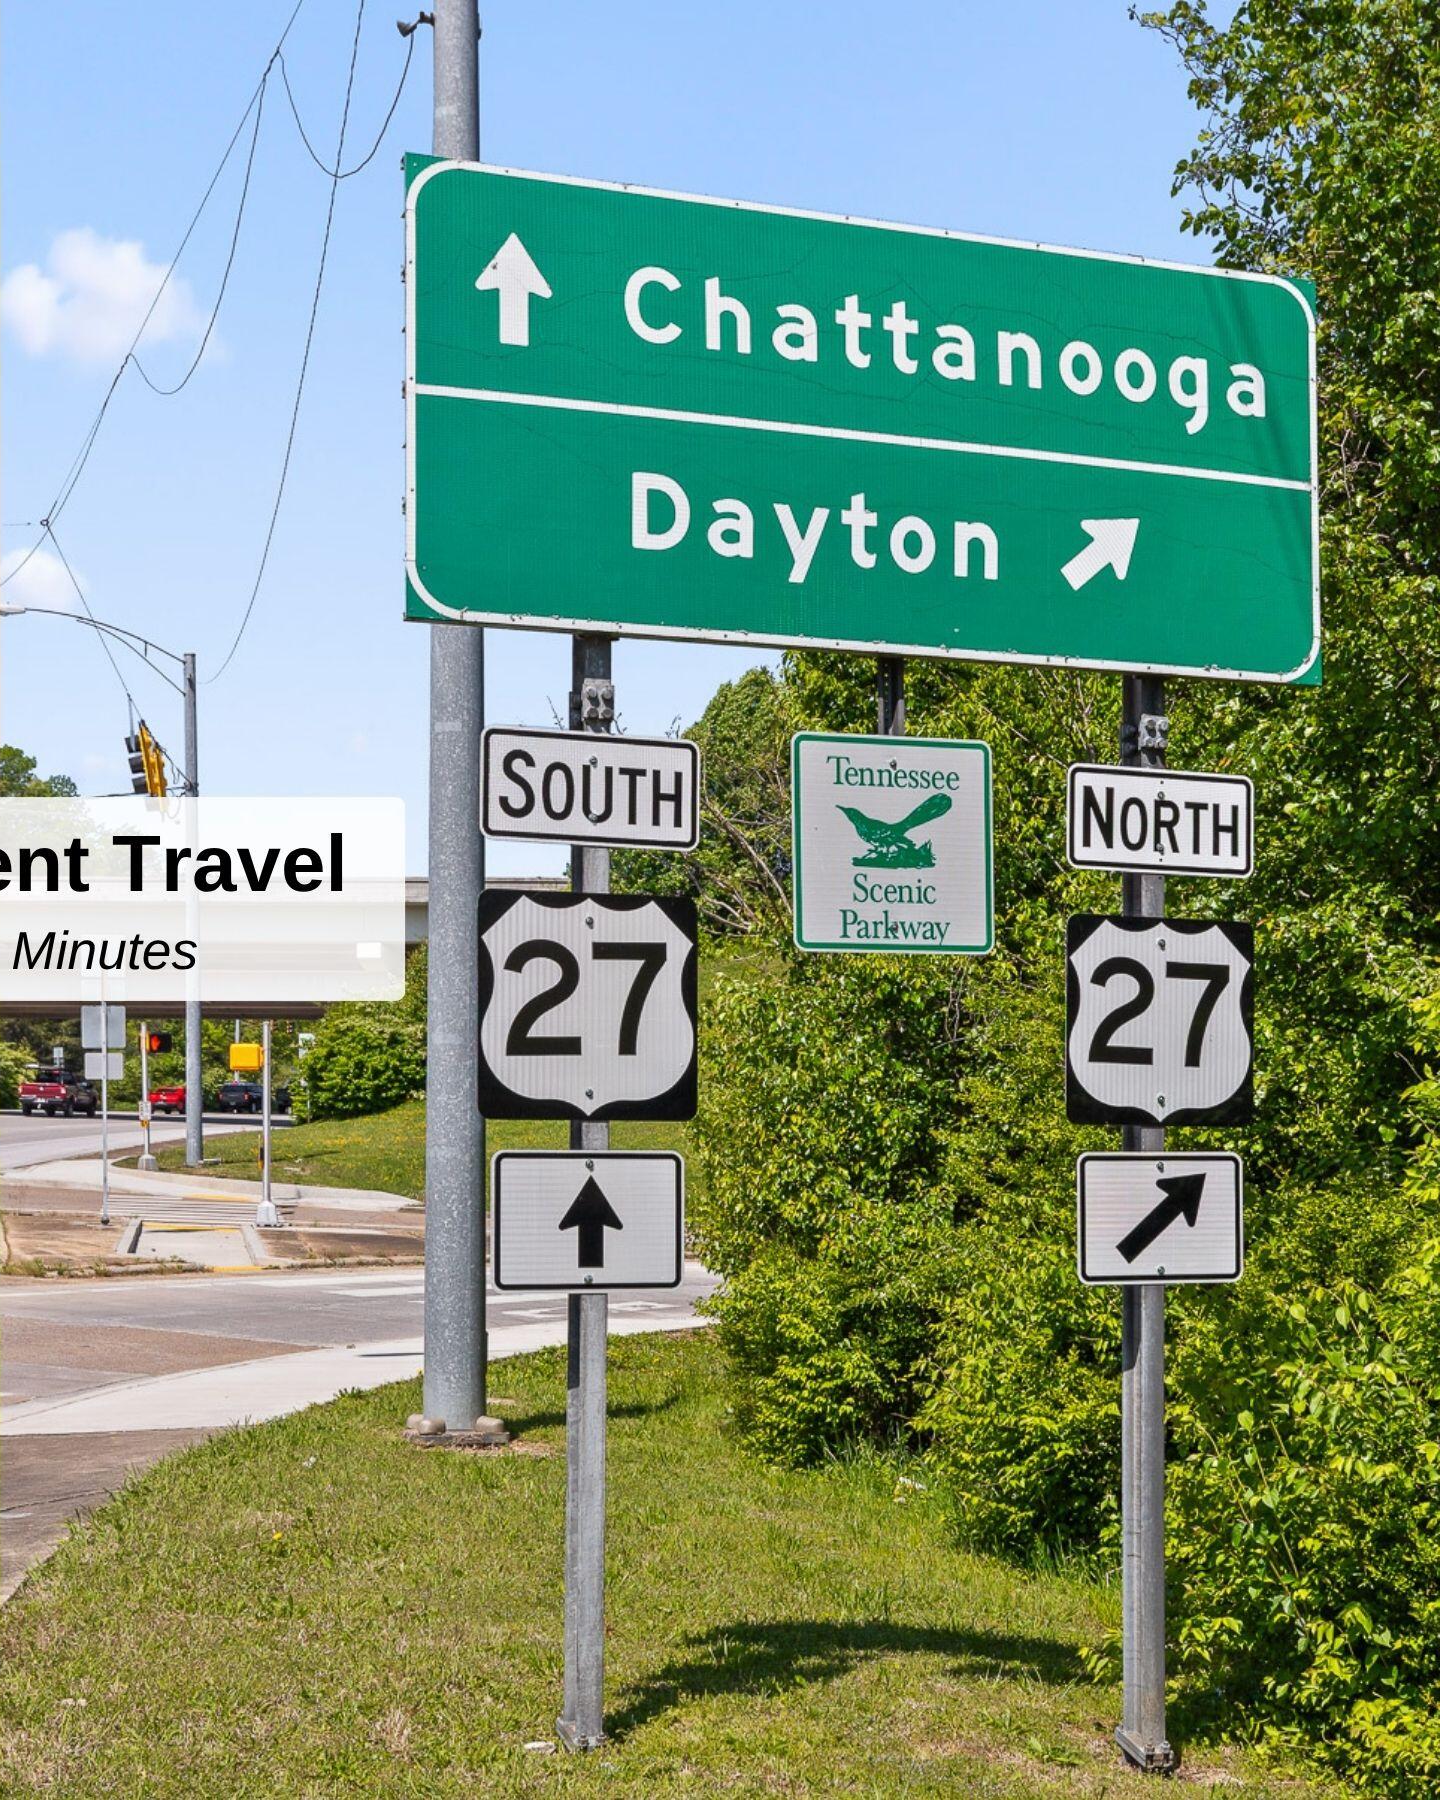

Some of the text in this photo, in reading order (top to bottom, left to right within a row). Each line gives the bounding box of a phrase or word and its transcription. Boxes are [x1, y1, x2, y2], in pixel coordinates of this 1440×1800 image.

[624, 265, 1267, 435] Chattanooga
[632, 472, 998, 583] Dayton
[498, 748, 683, 829] SOUTH
[826, 755, 960, 791] Tennessee
[1082, 785, 1239, 857] NORTH
[839, 909, 950, 946] Parkway
[852, 874, 936, 904] Scenic
[504, 940, 666, 1056] 27
[1089, 957, 1229, 1067] 27
